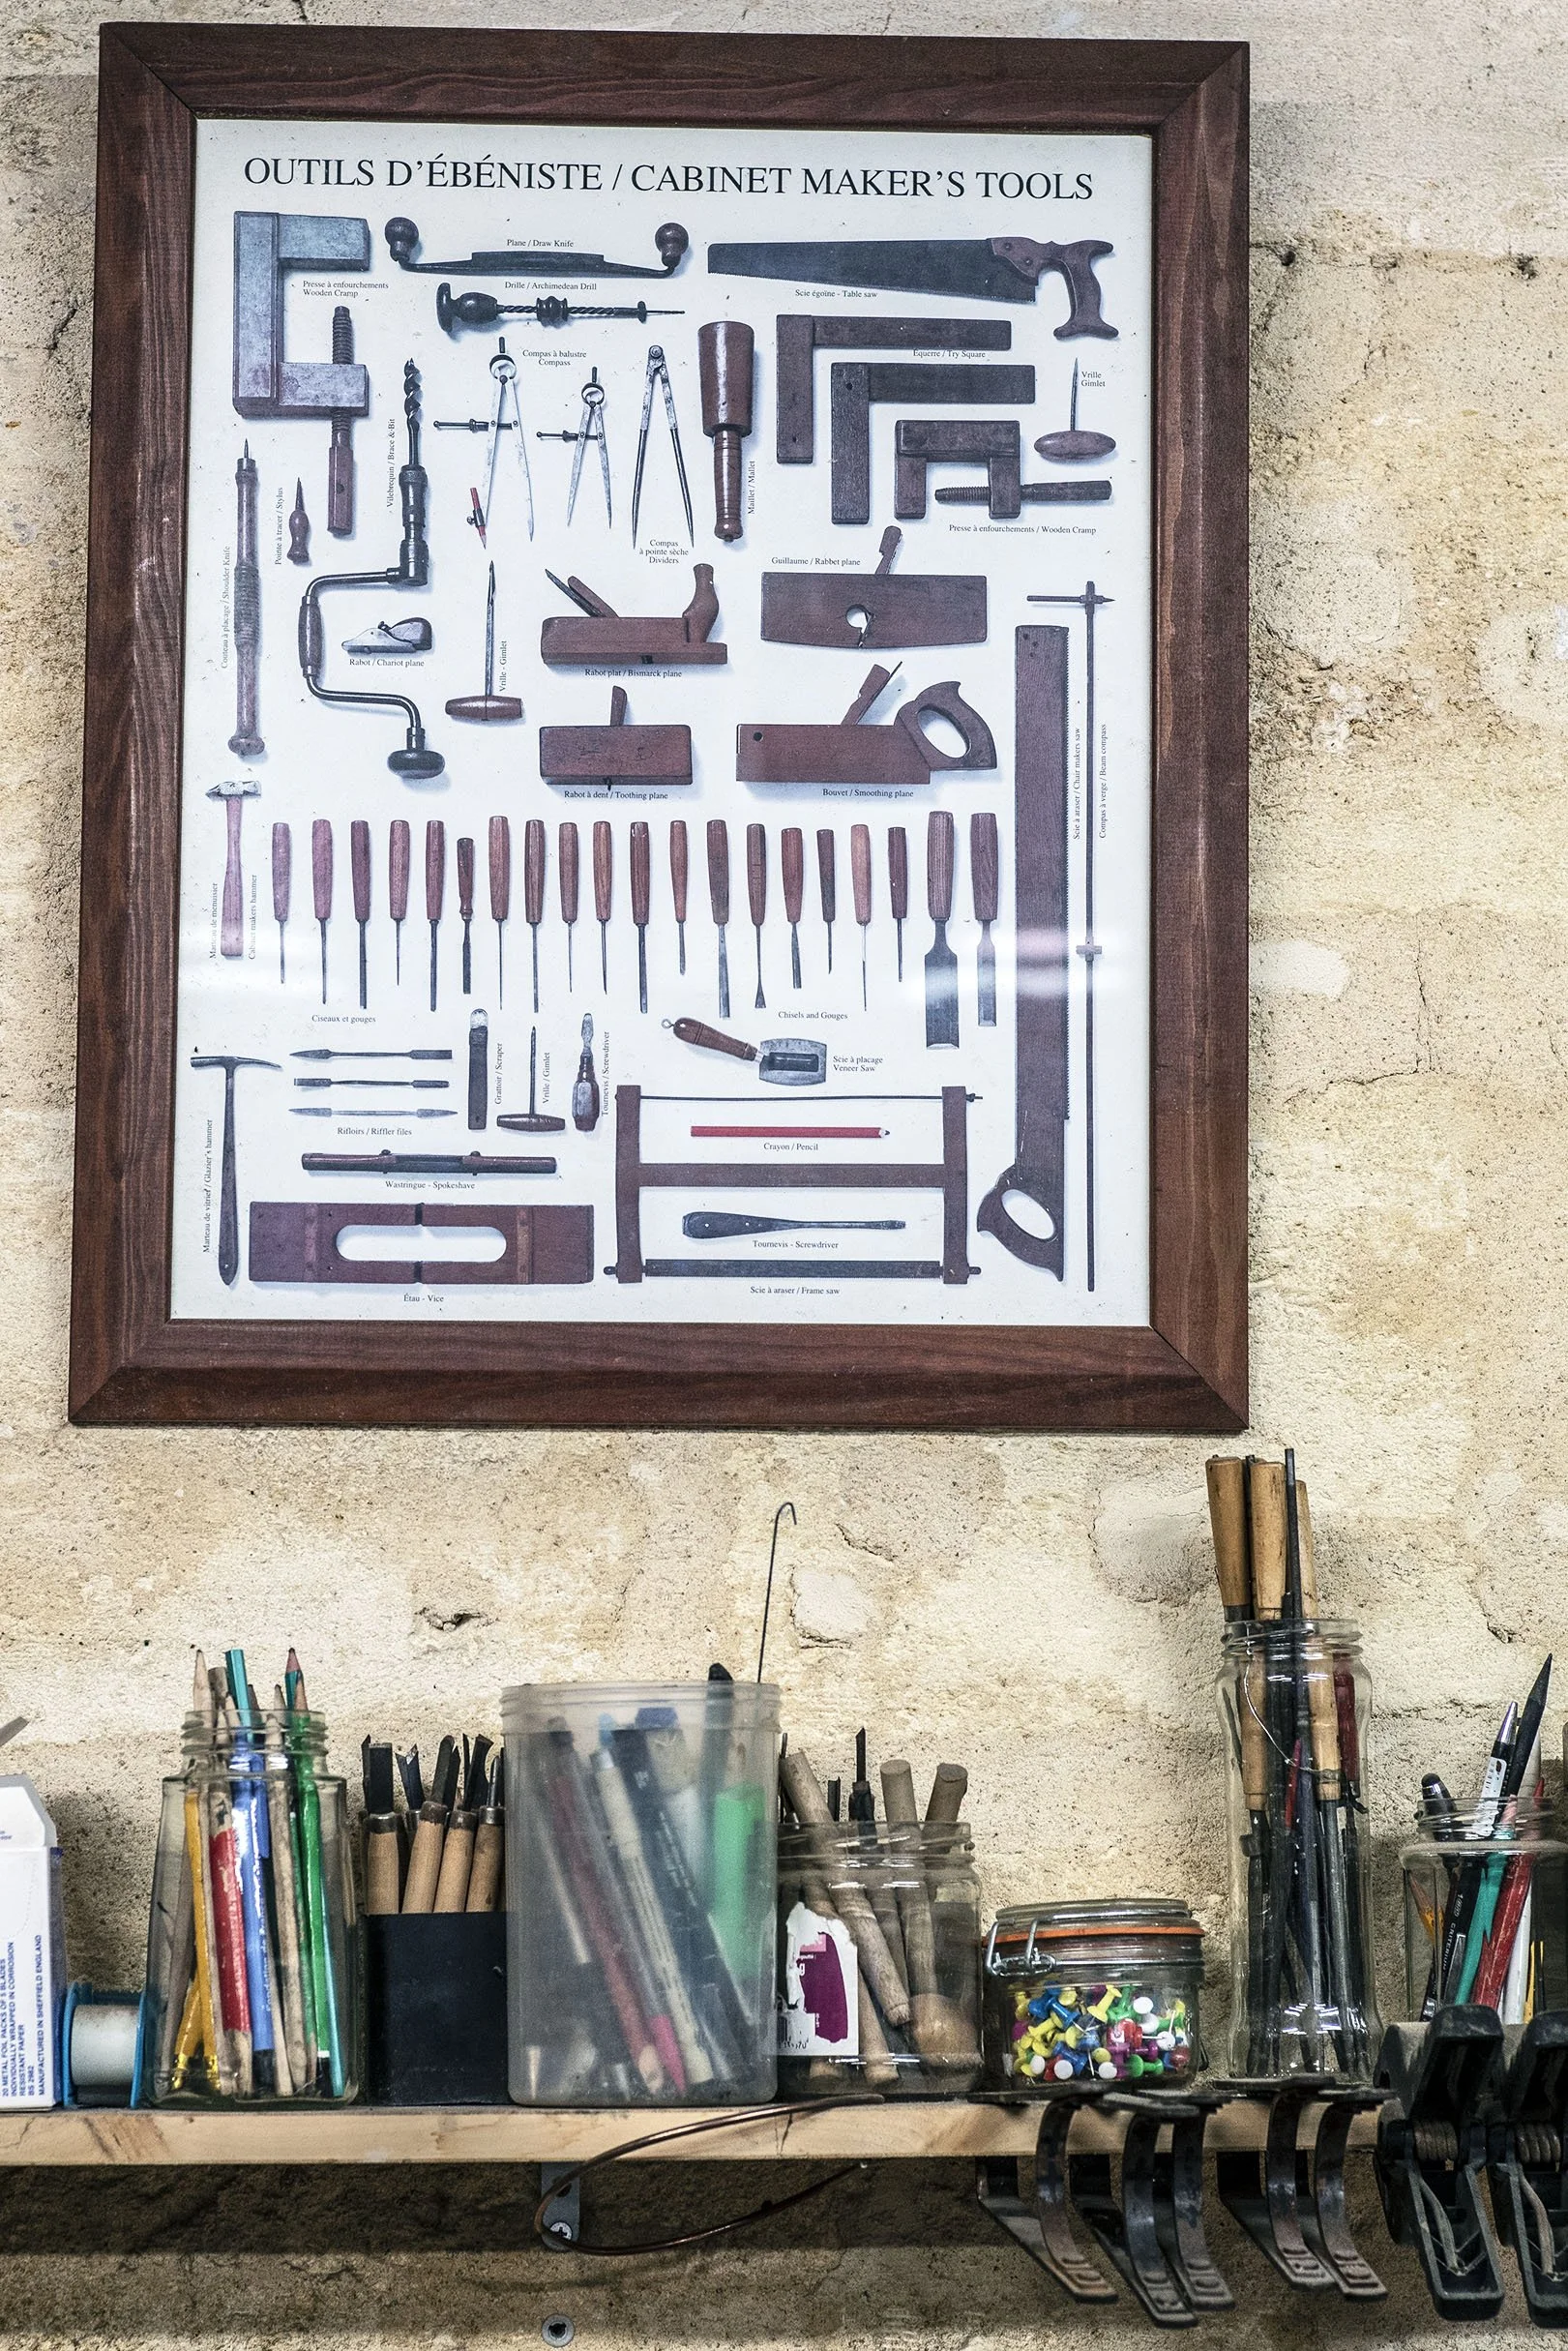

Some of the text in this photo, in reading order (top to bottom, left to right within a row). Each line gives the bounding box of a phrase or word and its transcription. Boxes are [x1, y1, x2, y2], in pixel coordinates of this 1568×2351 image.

[244, 157, 374, 187] OUTILS
[386, 152, 603, 191] D'ÉBÉNISTE
[631, 164, 792, 194] CABINET
[800, 167, 965, 198] MAKER'S
[975, 171, 1093, 200] TOOLS
[506, 238, 527, 247] Plane
[553, 239, 575, 248] Knife
[302, 280, 326, 288] Presse
[332, 280, 389, 289] enfourchements
[504, 281, 525, 289] Drille
[531, 282, 578, 290] Archimedean
[303, 288, 359, 299] Wooden Cramp
[794, 288, 811, 297] Scie
[842, 289, 863, 298] Table
[521, 349, 551, 360] Compas
[558, 349, 587, 358] balustre
[946, 349, 962, 360] Try
[961, 349, 987, 360] Square
[538, 357, 572, 368] Compass
[1080, 371, 1102, 379] Vrille
[1080, 378, 1106, 388] Gimlet
[387, 418, 396, 430] Bit
[387, 439, 396, 461] Brace
[386, 466, 397, 508] Vilebrequin
[275, 487, 285, 510] Stylus
[747, 490, 755, 515] Maillet
[949, 523, 972, 532] Presse
[978, 524, 1035, 533] enfourchements
[1041, 525, 1071, 534] Wooden
[1072, 525, 1097, 536] Cramp
[649, 539, 679, 549] Compas
[222, 546, 231, 566] Knife
[274, 542, 282, 565] Pointe
[645, 548, 667, 557] pointe
[668, 548, 689, 556] sèche
[649, 555, 680, 564] Dividers
[771, 556, 861, 567] Guillaume Rabbet plane
[222, 567, 231, 600] Shoulder
[221, 605, 231, 633] placage
[221, 639, 229, 670] Couteau
[376, 658, 403, 667] Chariot
[404, 659, 425, 669] plane
[498, 640, 508, 692] Vrille Gimlet
[607, 669, 622, 678] plat
[627, 669, 662, 677] Bismarck
[663, 670, 683, 679] plane
[1073, 742, 1081, 768] makers
[1072, 769, 1080, 790] Chair
[564, 789, 585, 798] Rabot
[592, 790, 608, 799] dent
[614, 790, 647, 801] Toothing
[648, 791, 668, 801] plane
[822, 788, 914, 799] Bouvet Smoothing plane
[1098, 809, 1109, 839] Compas
[1072, 823, 1080, 840] Scie
[249, 874, 257, 904] hammer
[210, 882, 219, 918] menuisier
[311, 1014, 340, 1023] Ciseaux
[350, 1016, 376, 1025] gouges
[778, 1010, 848, 1022] Chisels and Gouges
[832, 1055, 849, 1063] Scie
[856, 1056, 884, 1065] placage
[493, 1042, 505, 1105] Grattoir Scraper
[601, 1030, 610, 1117] Tournevis Screwdriver
[832, 1063, 876, 1072] Veneer Saw
[542, 1052, 550, 1104] Vrille Gimlet
[204, 1118, 213, 1149] hammer
[337, 1126, 412, 1136] Rifloirs Riffler files
[763, 1142, 818, 1152] Crayon Pencil
[203, 1149, 213, 1183] Glazier's
[385, 1180, 476, 1191] Wastringue Spokeshave
[203, 1212, 211, 1222] de
[202, 1223, 211, 1253] Marteau
[752, 1239, 840, 1249] Tournevis Screwdriver
[750, 1285, 766, 1295] Scie
[801, 1286, 825, 1295] Frame
[403, 1292, 445, 1303] Étau Vice
[8, 1991, 15, 2001] IN
[35, 1975, 44, 2019] SHEFFIELD
[0, 1999, 8, 2010] OF
[8, 2001, 16, 2042] WRAPPED
[36, 2019, 44, 2029] IN
[0, 2039, 9, 2059] FOIL
[37, 2029, 45, 2096] MANUFACTURED
[9, 2042, 17, 2097] INDIVIDUALLY
[17, 2053, 26, 2097] RESISTANT
